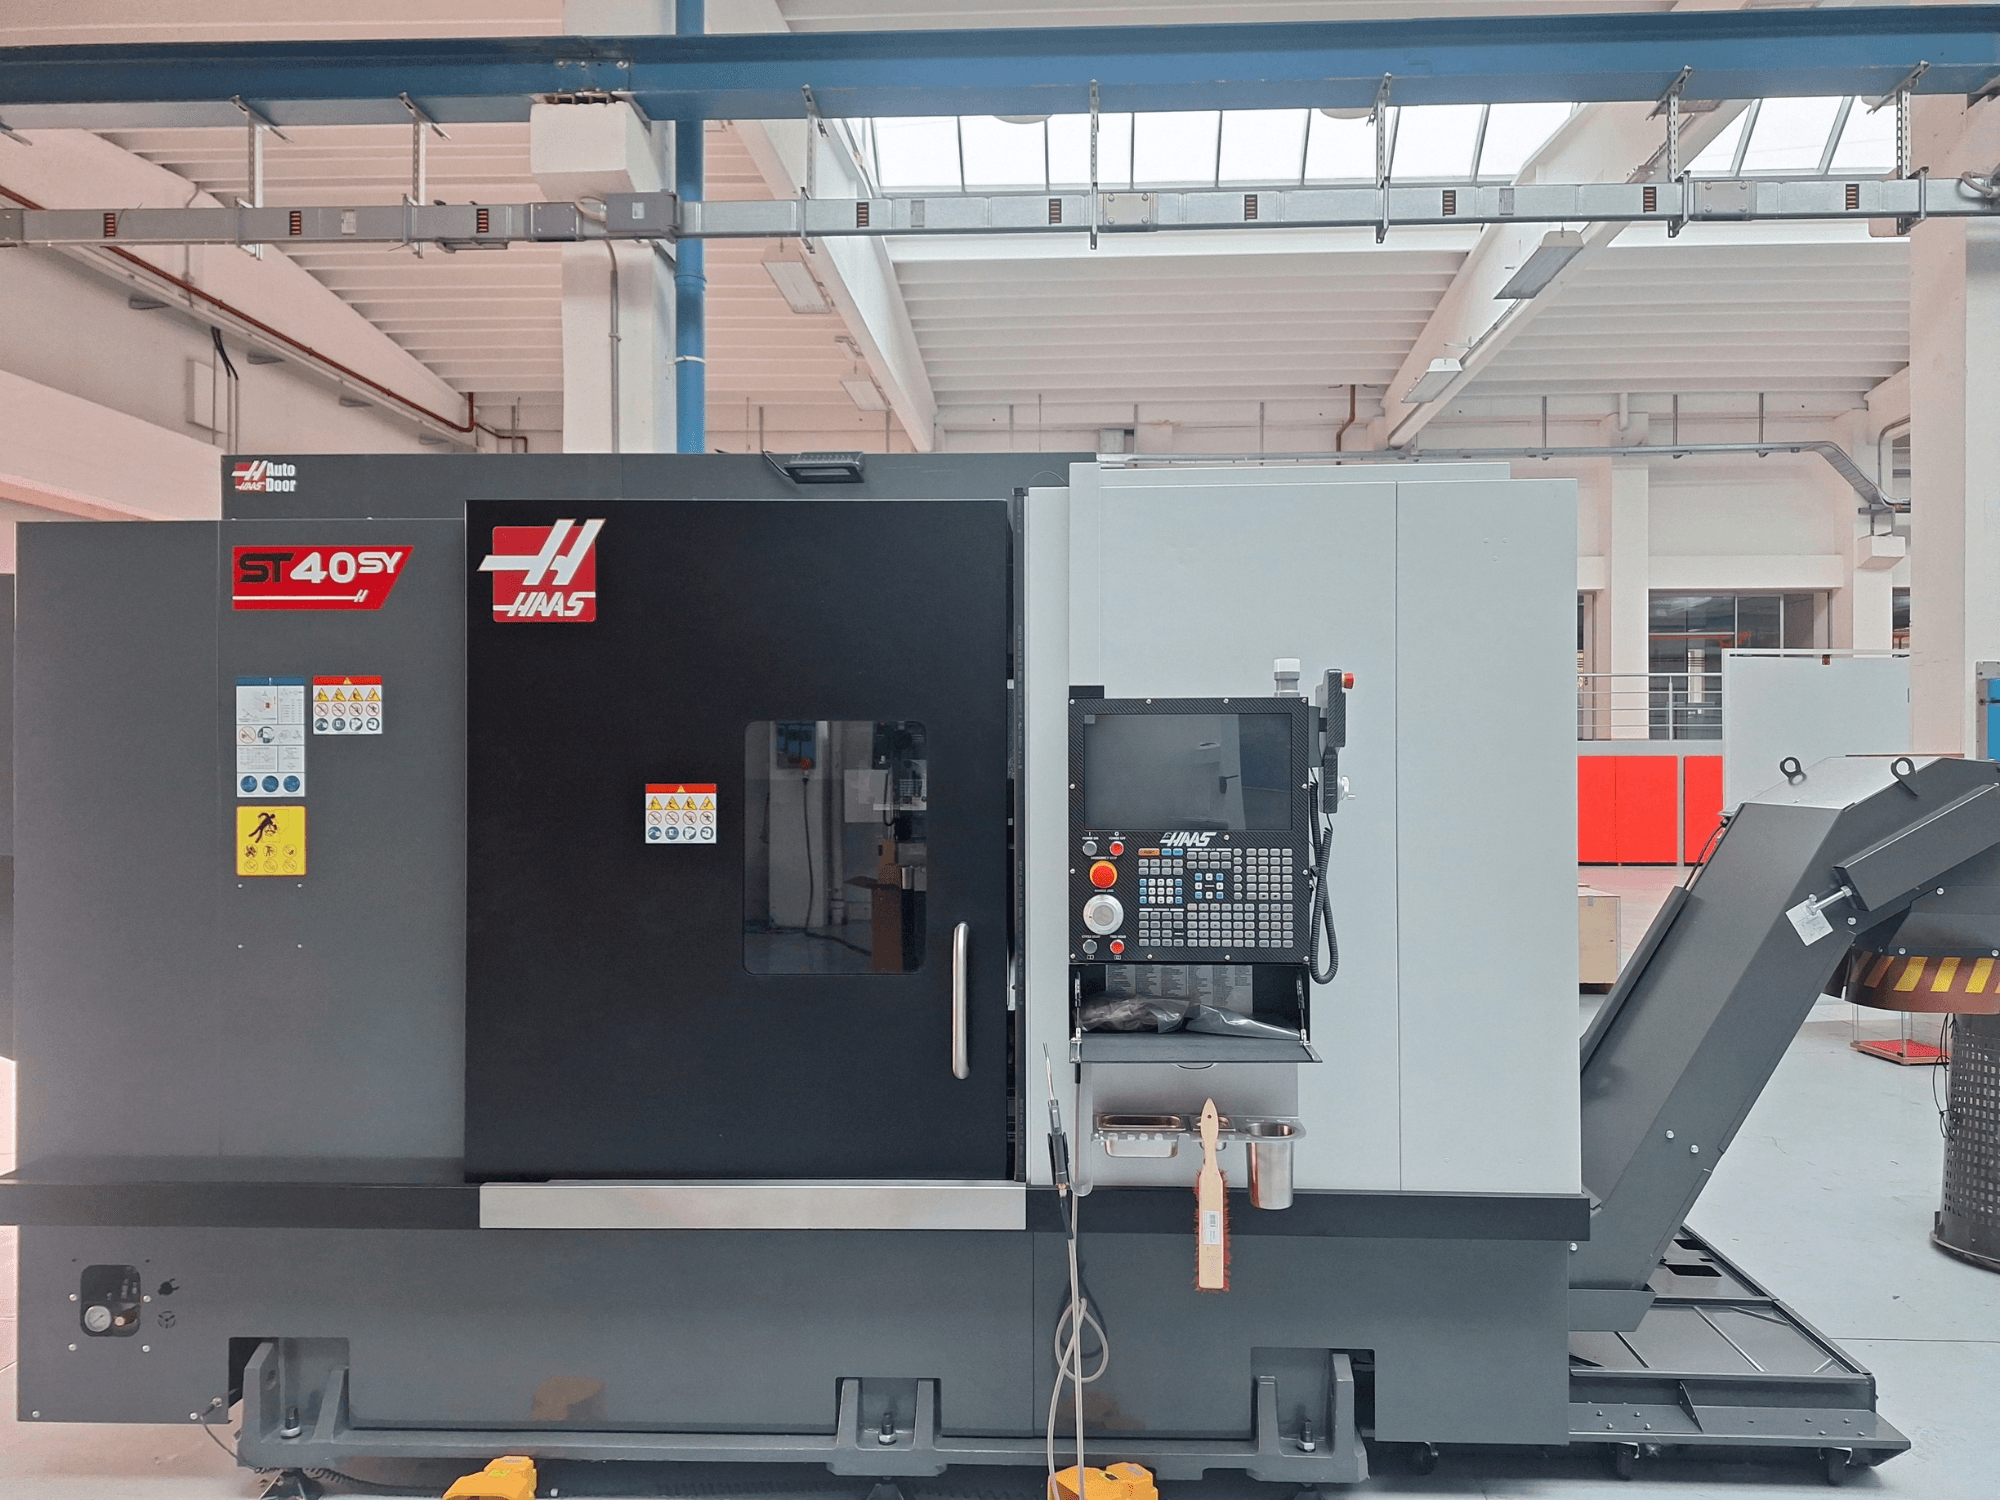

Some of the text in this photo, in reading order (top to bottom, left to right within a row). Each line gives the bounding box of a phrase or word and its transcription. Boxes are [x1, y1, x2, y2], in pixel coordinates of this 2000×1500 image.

[266, 462, 296, 477] Auto
[235, 481, 265, 491] HAAS
[265, 478, 296, 492] Door
[493, 591, 596, 617] HAAS
[1160, 831, 1217, 847] HAAS
